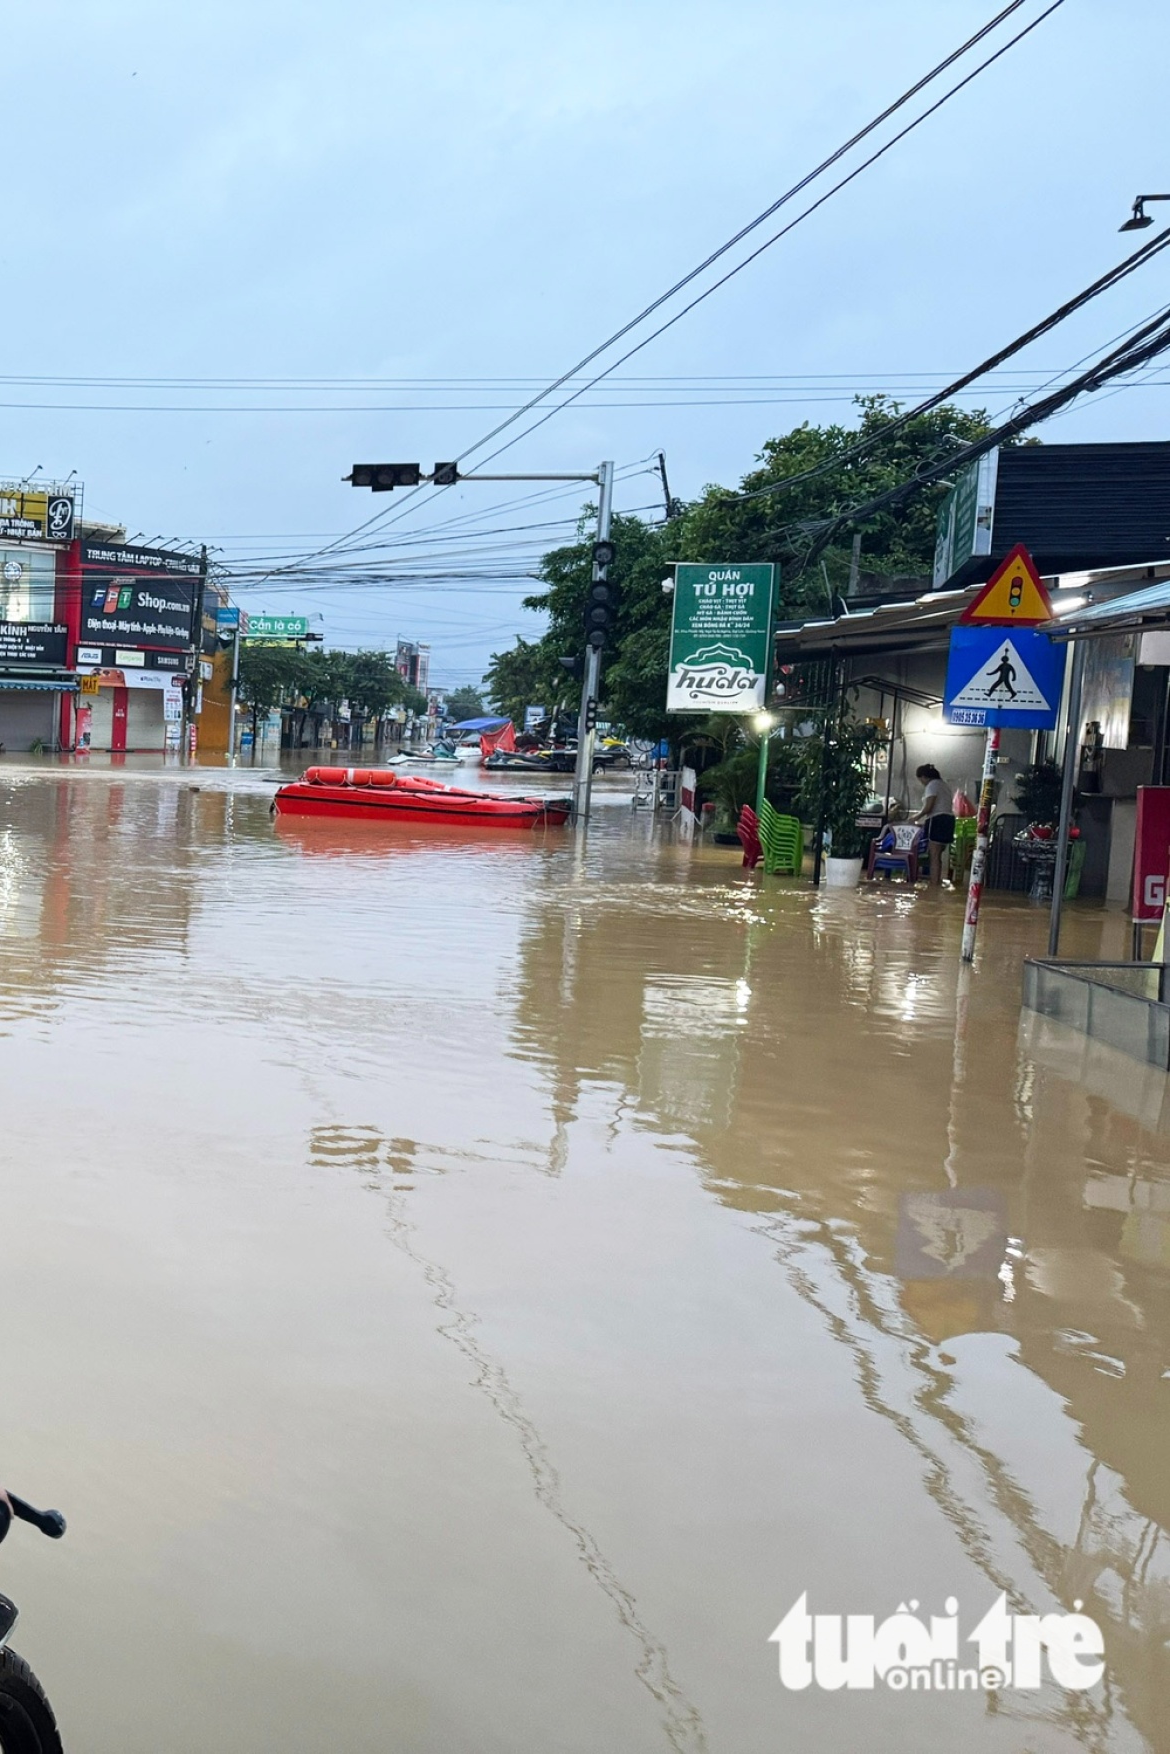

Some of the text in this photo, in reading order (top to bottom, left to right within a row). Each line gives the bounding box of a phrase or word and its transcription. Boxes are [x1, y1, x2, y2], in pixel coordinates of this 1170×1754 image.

[708, 569, 741, 582] QUÁN
[692, 582, 755, 598] TÚ HỢI
[92, 588, 132, 608] FPT
[0, 623, 28, 636] KÍNH
[249, 618, 302, 631] Cần là có
[675, 666, 759, 690] huda
